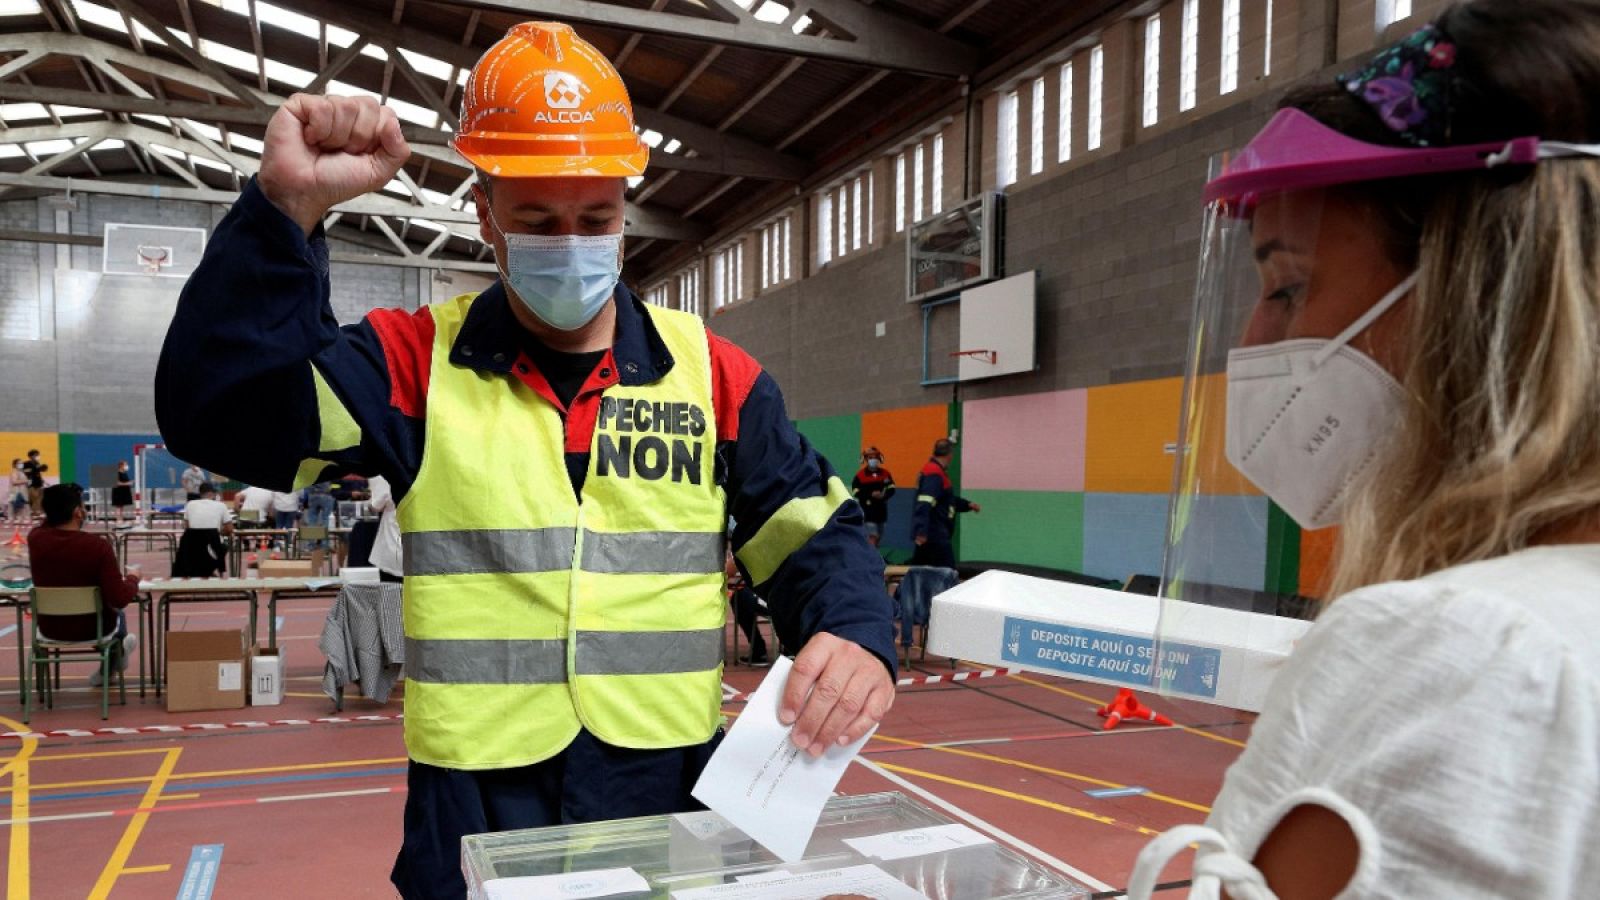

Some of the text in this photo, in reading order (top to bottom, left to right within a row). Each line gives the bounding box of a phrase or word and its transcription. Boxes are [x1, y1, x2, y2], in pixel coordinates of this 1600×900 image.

[534, 111, 595, 123] ALCOA
[599, 396, 706, 437] PECHES
[1303, 415, 1340, 456] KN95
[596, 433, 702, 485] NON
[1031, 629, 1088, 649] DEPOSITE
[1091, 639, 1124, 654] AQUÍ
[1125, 644, 1134, 657] O
[1168, 651, 1190, 665] DNI
[1037, 647, 1097, 668] DEPOSITE
[1098, 658, 1131, 673] AQUÍ
[1131, 663, 1149, 676] SU
